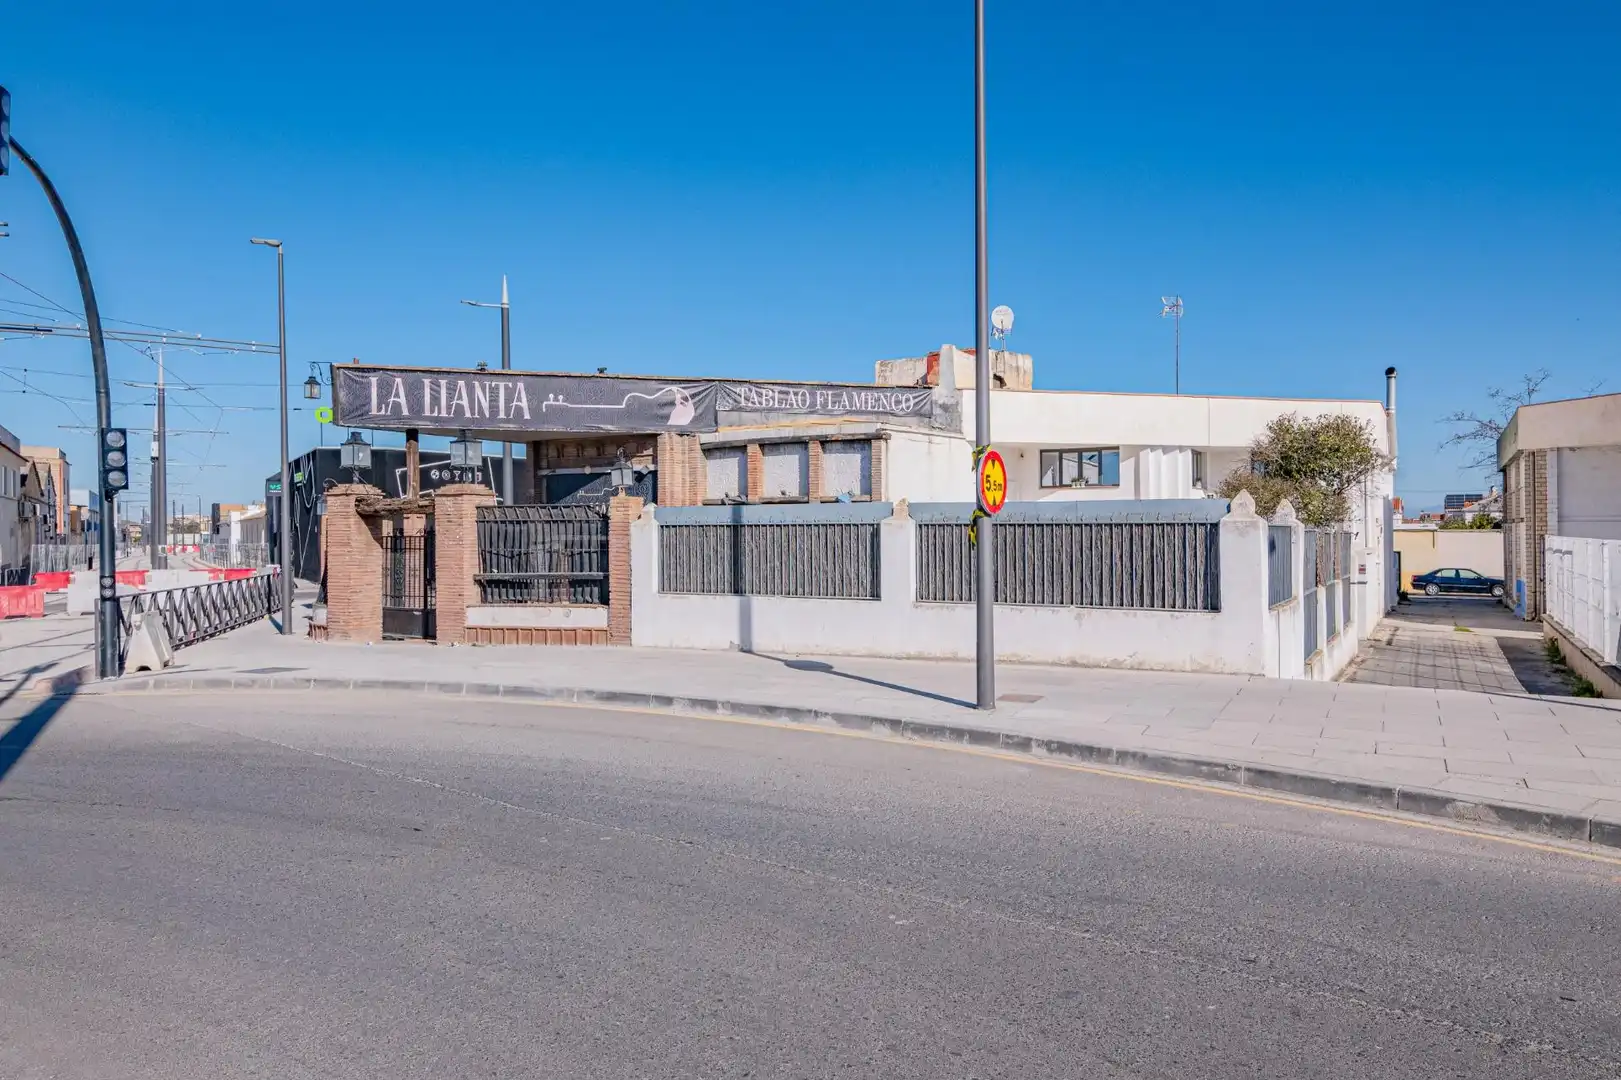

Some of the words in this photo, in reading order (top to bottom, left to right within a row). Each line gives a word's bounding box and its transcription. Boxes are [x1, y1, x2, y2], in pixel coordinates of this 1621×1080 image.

[368, 376, 411, 416] LA
[421, 377, 532, 420] LIANTA
[736, 386, 810, 410] TABLAO
[814, 389, 914, 413] FLAMENCO
